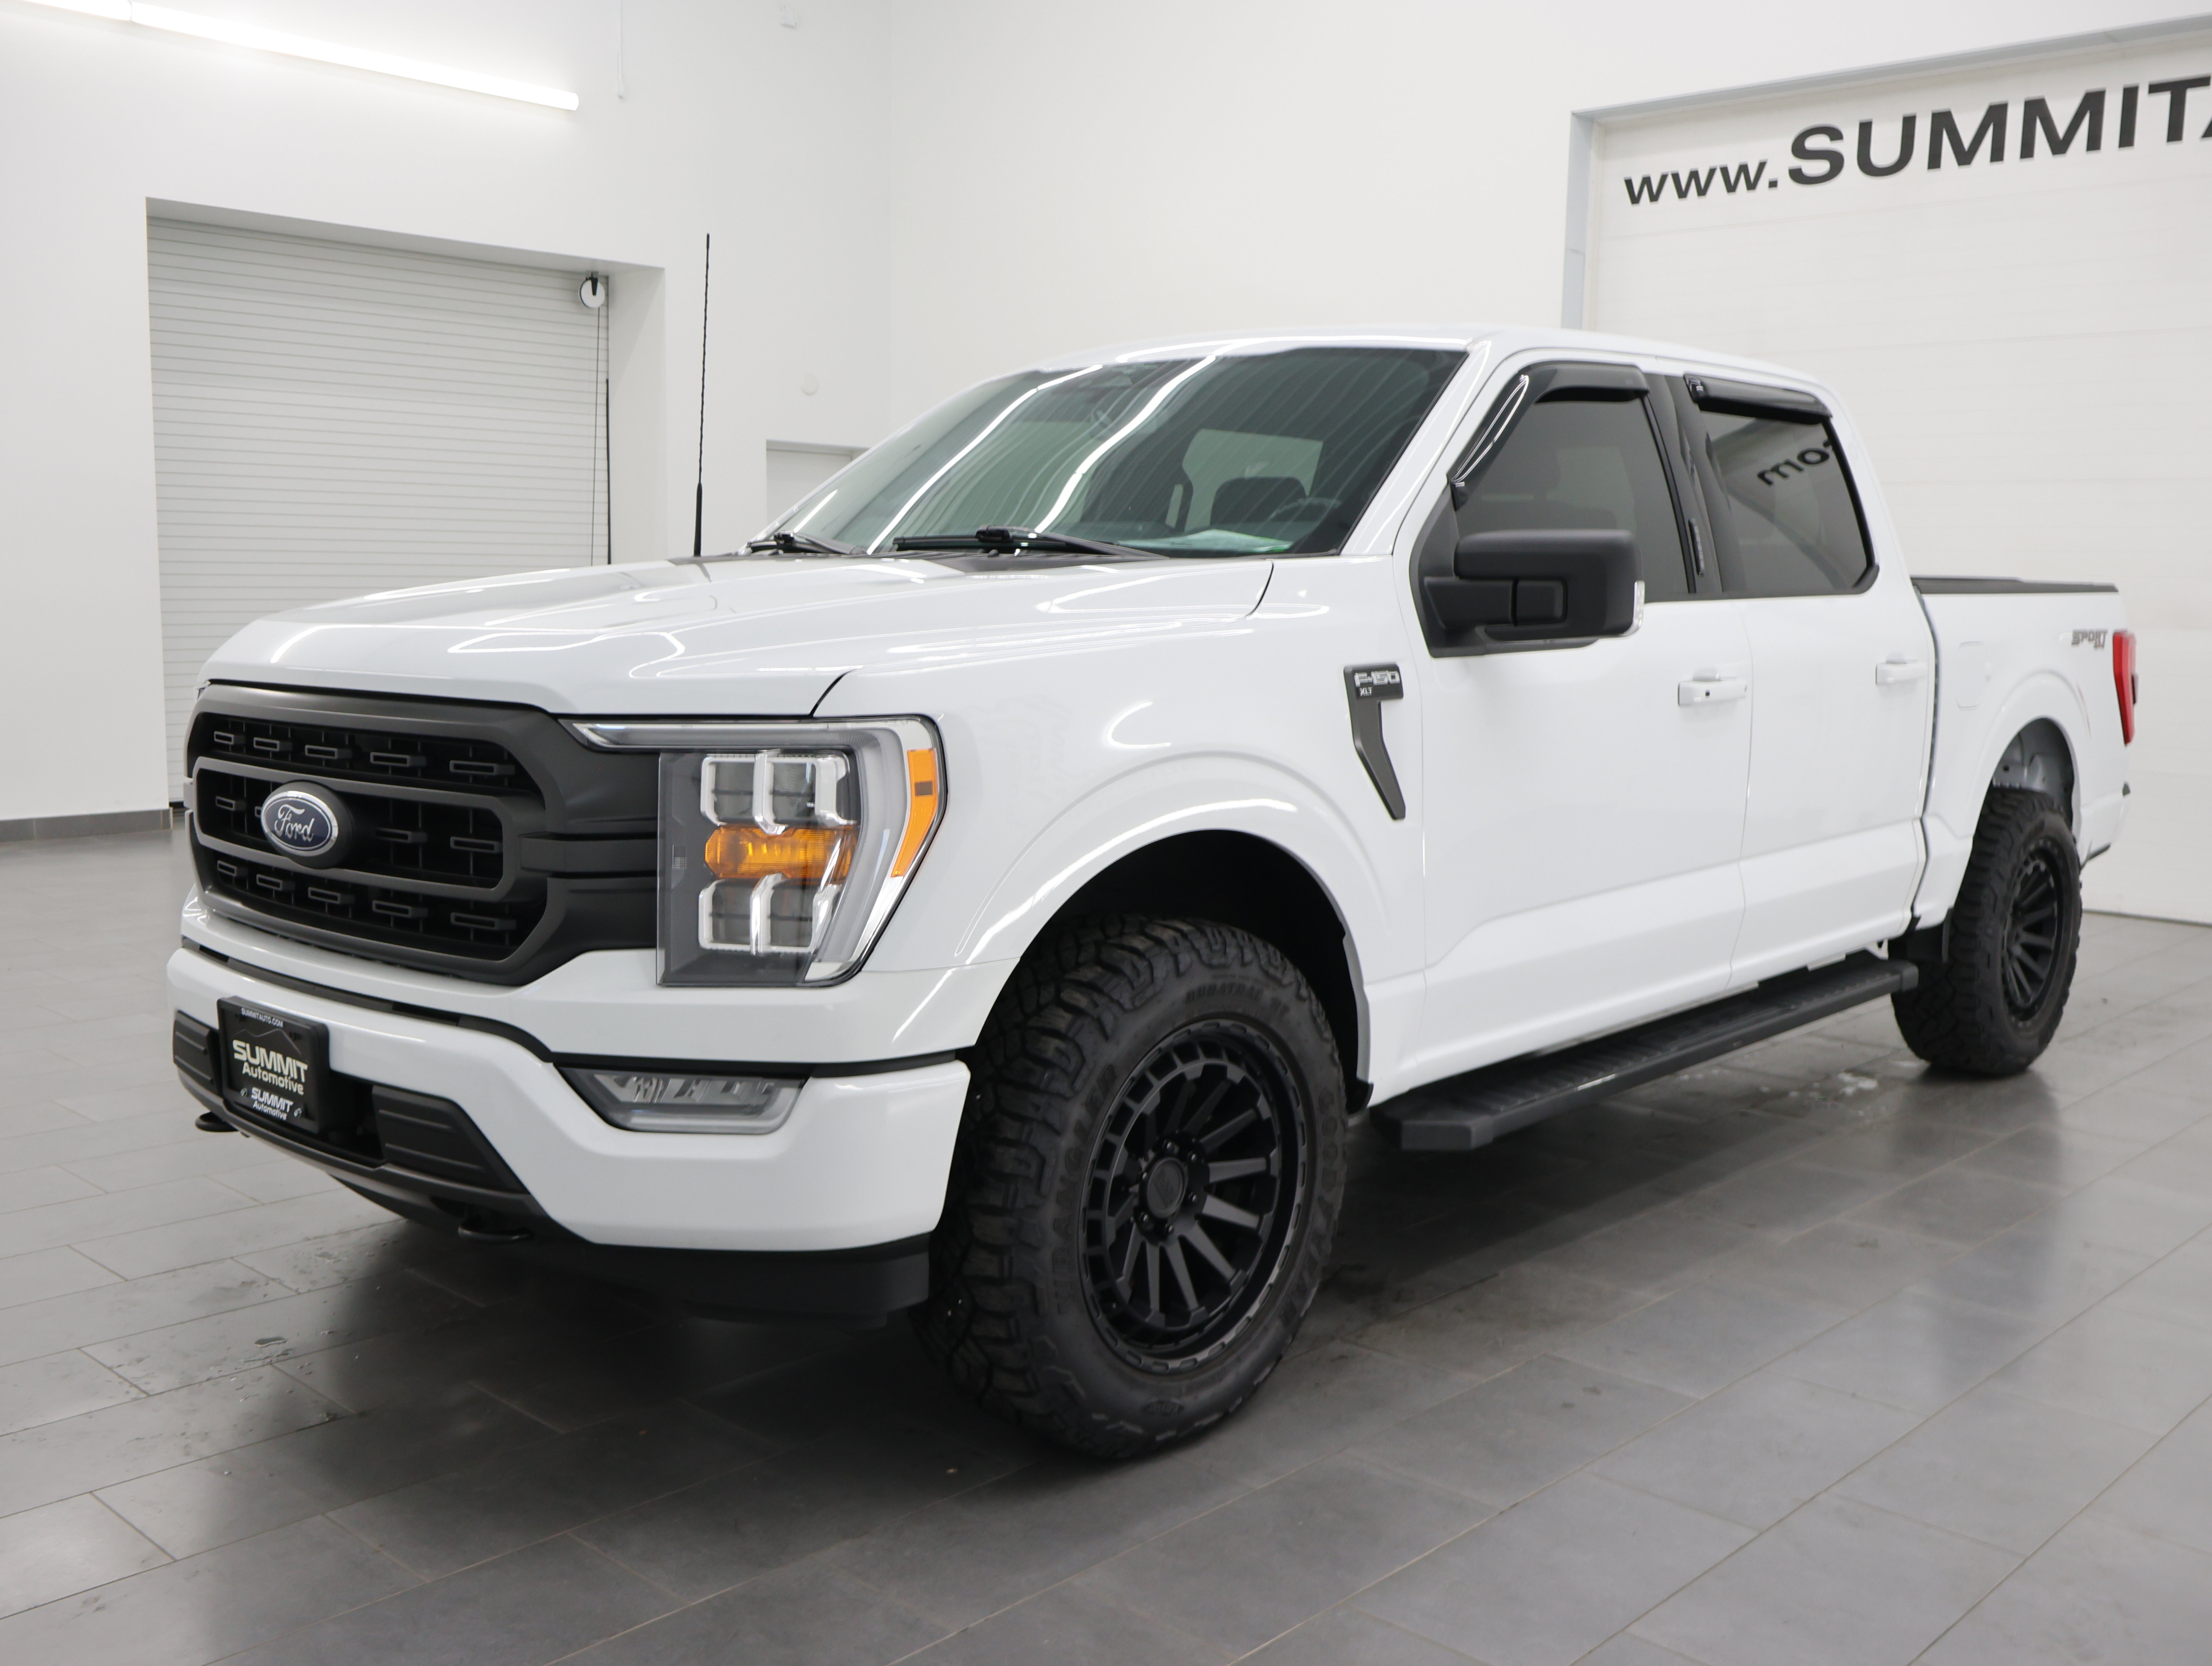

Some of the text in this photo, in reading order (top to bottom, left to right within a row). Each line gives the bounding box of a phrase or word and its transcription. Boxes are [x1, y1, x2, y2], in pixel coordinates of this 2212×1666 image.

[1624, 75, 2212, 205] www.SUMMIT
[1354, 670, 1400, 687] F-150
[1360, 687, 1372, 696] XLT
[274, 804, 315, 842] Ford
[241, 1008, 284, 1028] SUMMITAUTO.COM
[233, 1039, 308, 1083] SUMMIT
[242, 1061, 304, 1095] Automotive
[251, 1087, 294, 1113] SUMMIT
[253, 1101, 288, 1120] Automotive
